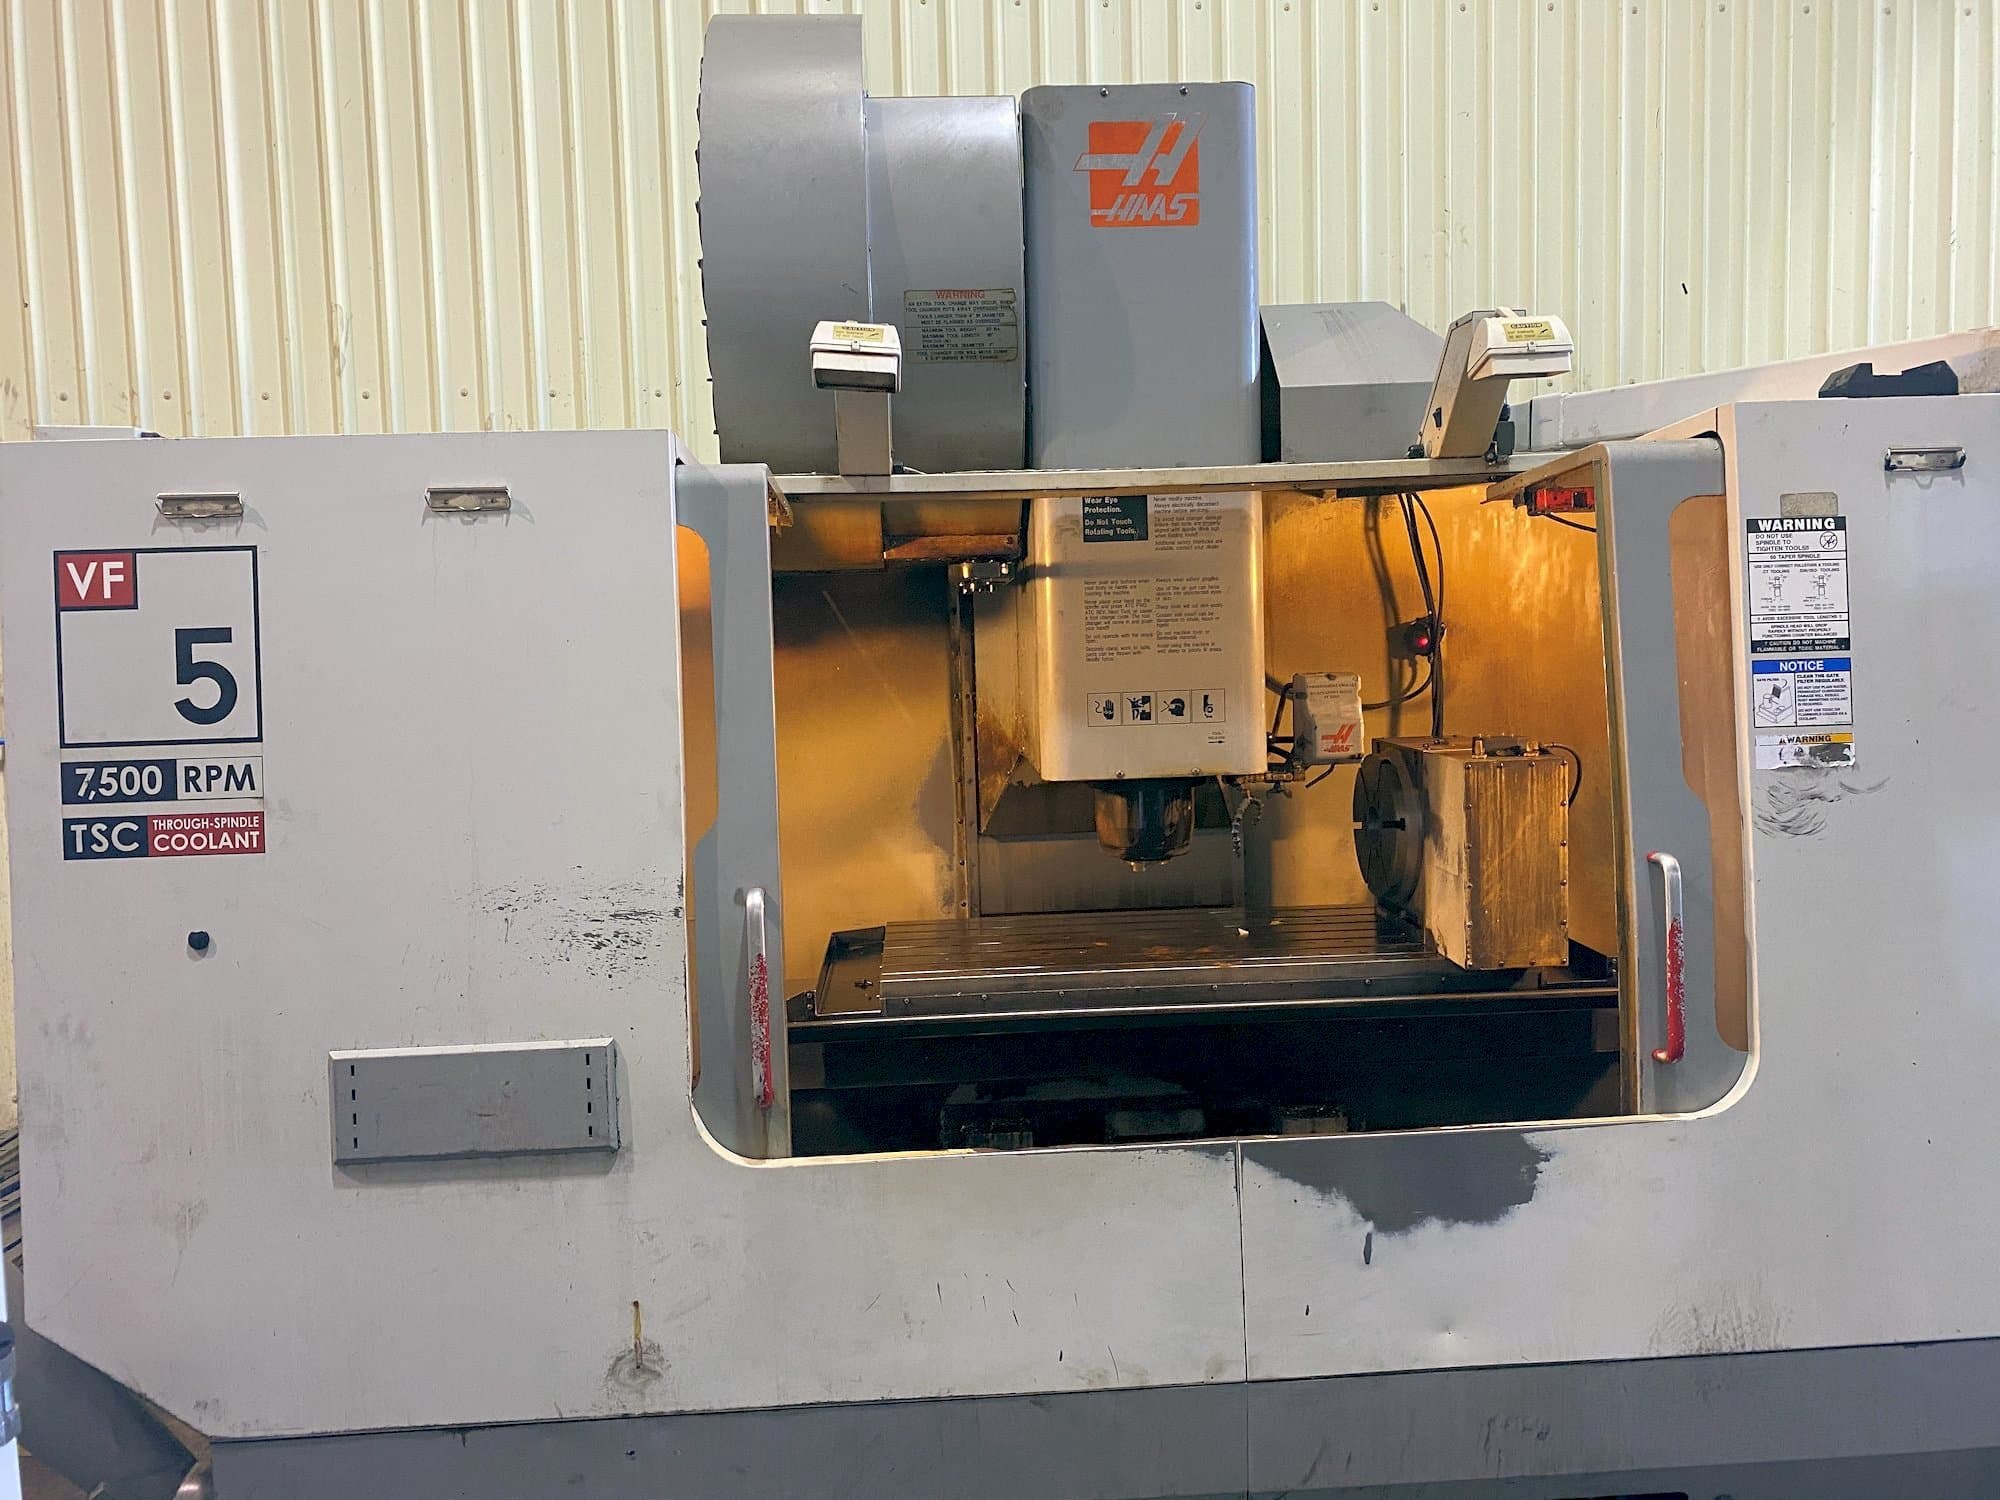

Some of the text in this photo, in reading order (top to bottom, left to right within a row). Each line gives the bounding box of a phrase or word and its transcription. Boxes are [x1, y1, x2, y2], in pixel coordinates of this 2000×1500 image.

[1091, 193, 1200, 221] HAAS
[936, 290, 984, 298] WARNING
[1085, 528, 1113, 536] Rotating
[1758, 518, 1835, 531] WARNING
[66, 561, 124, 600] VF
[1780, 660, 1824, 671] NOTICE
[174, 627, 238, 725] 5
[1787, 735, 1831, 743] WARNING
[74, 764, 255, 800] 7,500 RPM
[153, 816, 259, 831] THROUGH-SPINDLE
[70, 821, 139, 853] TSC
[153, 831, 260, 851] COOLANT
